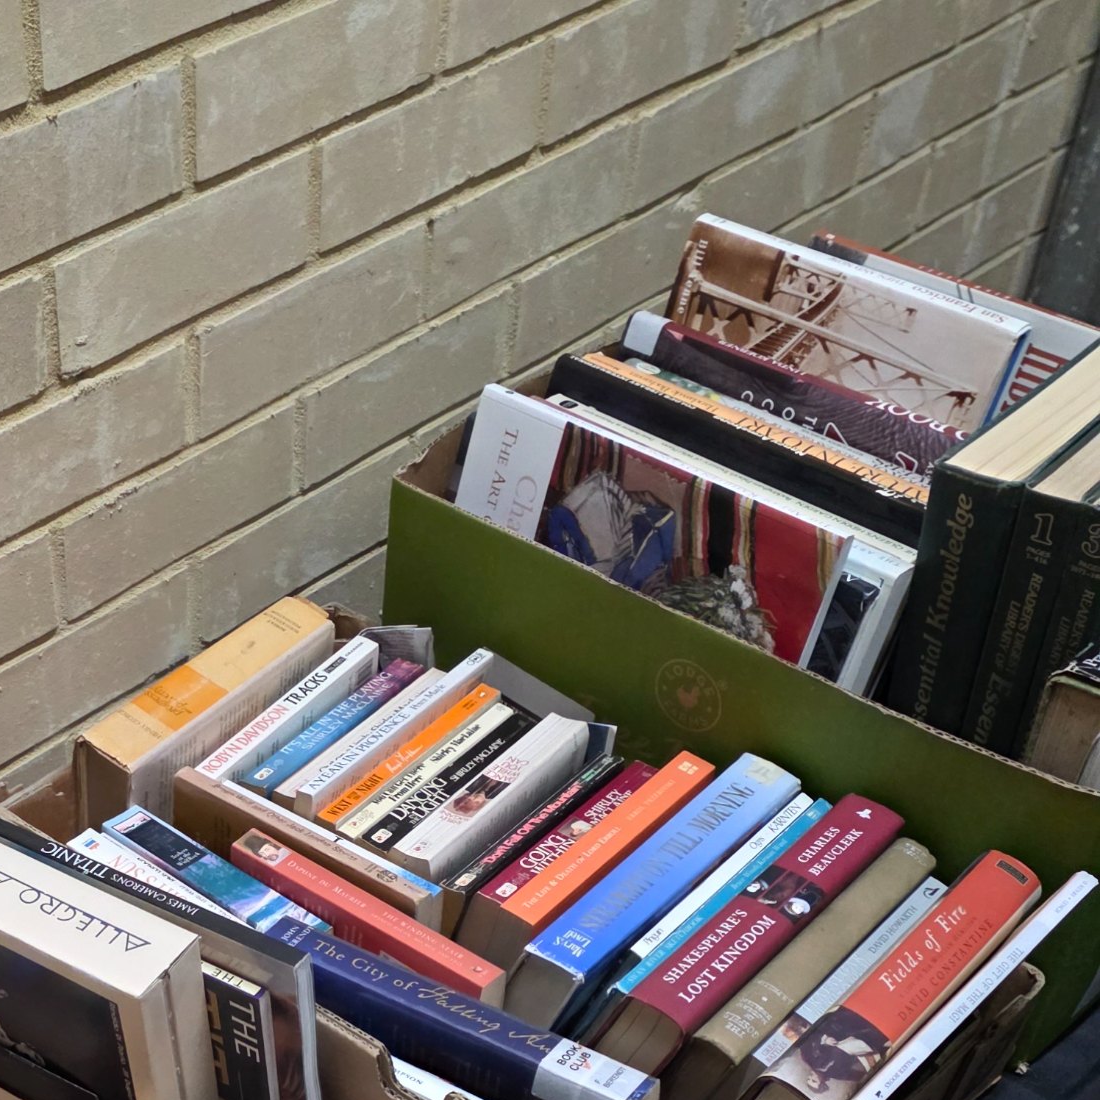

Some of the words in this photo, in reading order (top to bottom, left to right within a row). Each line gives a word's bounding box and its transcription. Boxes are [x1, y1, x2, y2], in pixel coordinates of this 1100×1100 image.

[910, 285, 980, 315] Francisco
[980, 308, 1010, 325] San
[500, 427, 520, 469] THE
[486, 472, 507, 511] ART
[926, 492, 974, 631] Knowledge
[201, 746, 239, 774] ROBYN
[237, 704, 291, 749] DAVIDSON
[283, 671, 329, 707] TRACKS
[279, 738, 301, 757] IT'S
[298, 723, 320, 743] ALL
[317, 715, 331, 730] IN
[328, 700, 352, 721] THE
[347, 670, 394, 705] PLAYING
[299, 716, 343, 753] SHIRLEY
[341, 681, 395, 721] MACLAINE
[326, 799, 353, 817] WEST
[355, 773, 385, 796] NIGHT
[389, 776, 448, 821] DANCING
[583, 788, 623, 819] SHIRLEY
[40, 841, 109, 880] TITANIC
[519, 833, 566, 869] GOING
[797, 825, 842, 864] CHARLES
[807, 828, 865, 878] BEAUCLERK
[109, 872, 168, 902] CAMERON'S
[165, 896, 201, 917] JAMES
[18, 886, 153, 953] ALLEGRO
[662, 908, 749, 986] SHAKESPEARE'S
[677, 962, 718, 1004] LOST
[712, 913, 778, 970] KINGDOM
[877, 948, 926, 994] Fields
[923, 928, 942, 953] of
[933, 902, 969, 935] Fire
[1006, 947, 1026, 965] THE
[314, 939, 345, 962] The
[352, 957, 390, 981] City
[393, 979, 420, 992] of
[417, 985, 501, 1033] Falling
[896, 988, 931, 1023] DAVID
[928, 916, 995, 988] CONSTANTINE
[982, 977, 994, 991] OF
[991, 960, 1010, 980] GIFT
[948, 1002, 970, 1024] MAGI
[965, 988, 986, 1005] THE
[227, 1000, 262, 1064] THE
[556, 1043, 581, 1067] BOOK
[568, 1050, 592, 1072] CLUB
